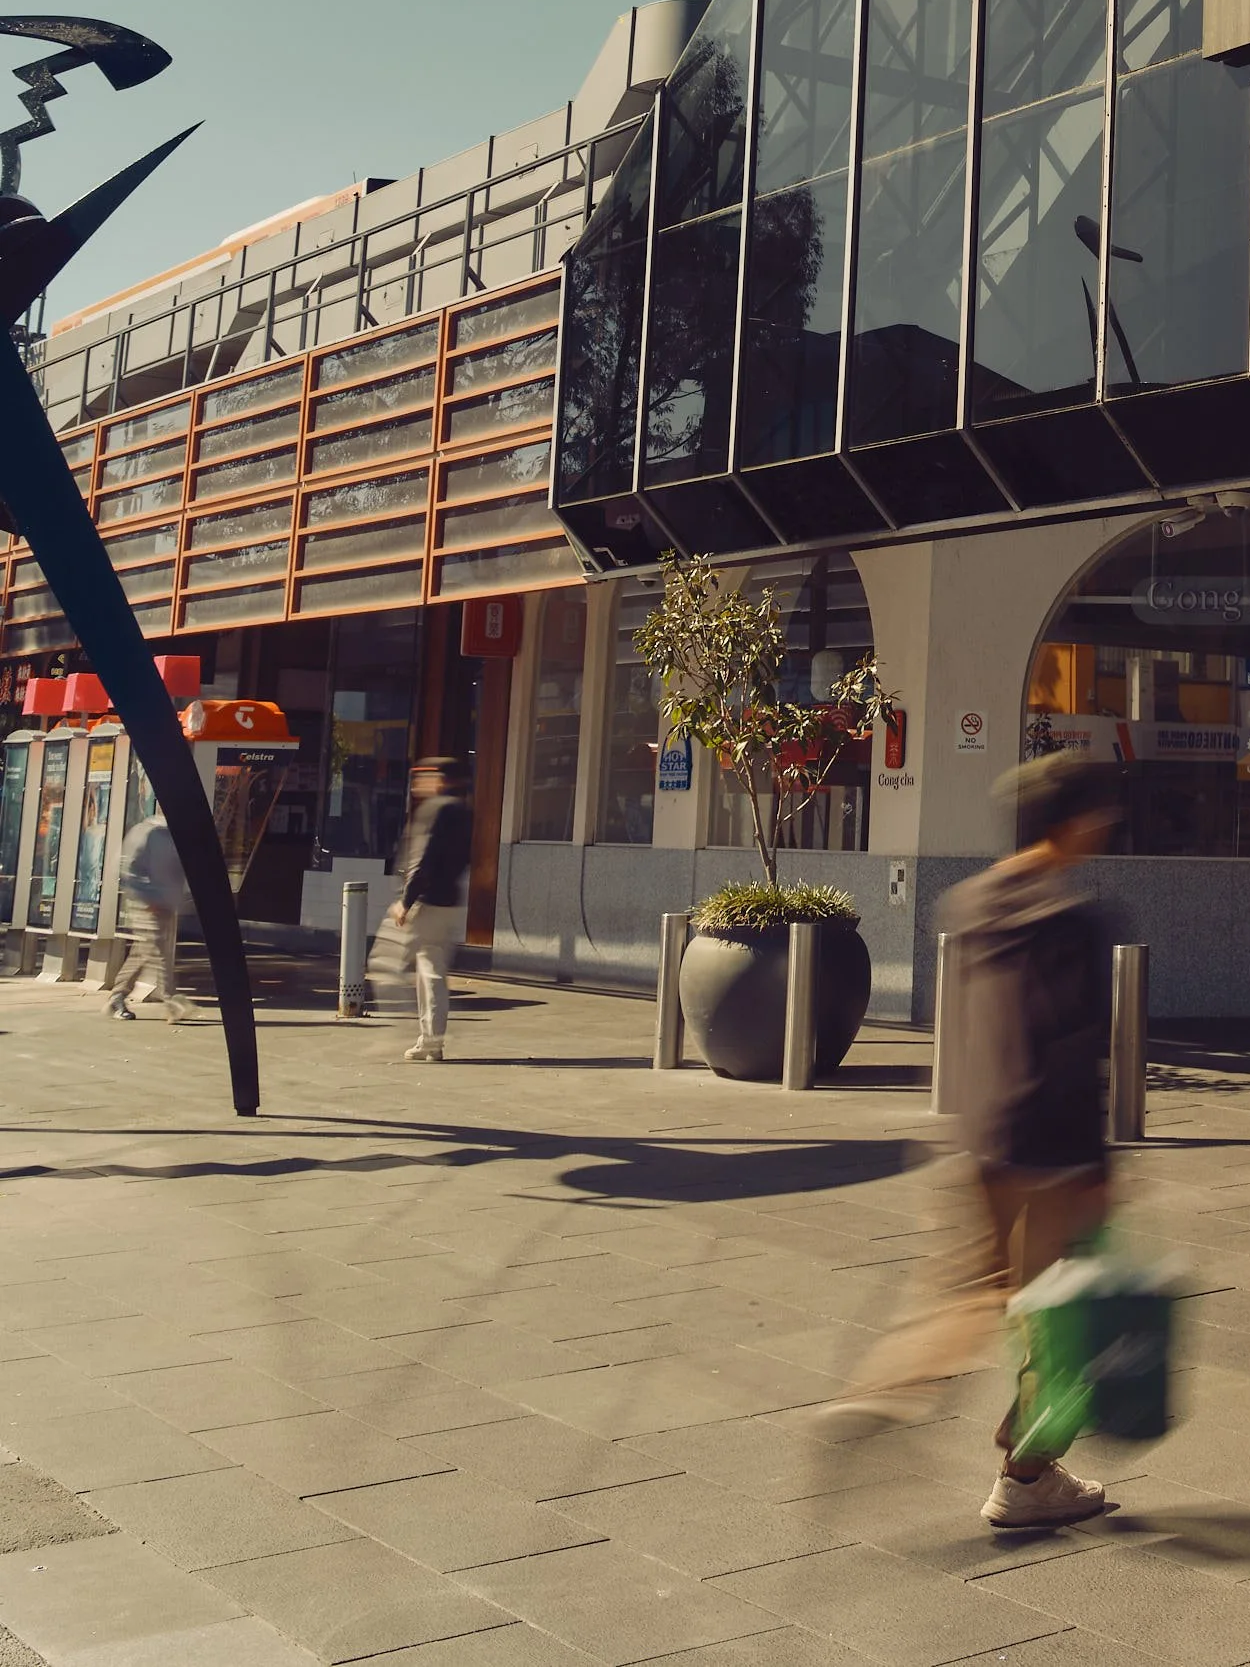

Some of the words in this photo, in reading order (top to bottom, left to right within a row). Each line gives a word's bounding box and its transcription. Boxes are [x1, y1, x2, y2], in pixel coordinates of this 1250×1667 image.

[1147, 581, 1243, 622] Gong
[240, 752, 275, 763] Telstra
[664, 752, 685, 762] HOT
[660, 762, 687, 771] STAR
[878, 774, 900, 790] Gong
[900, 772, 915, 787] cha
